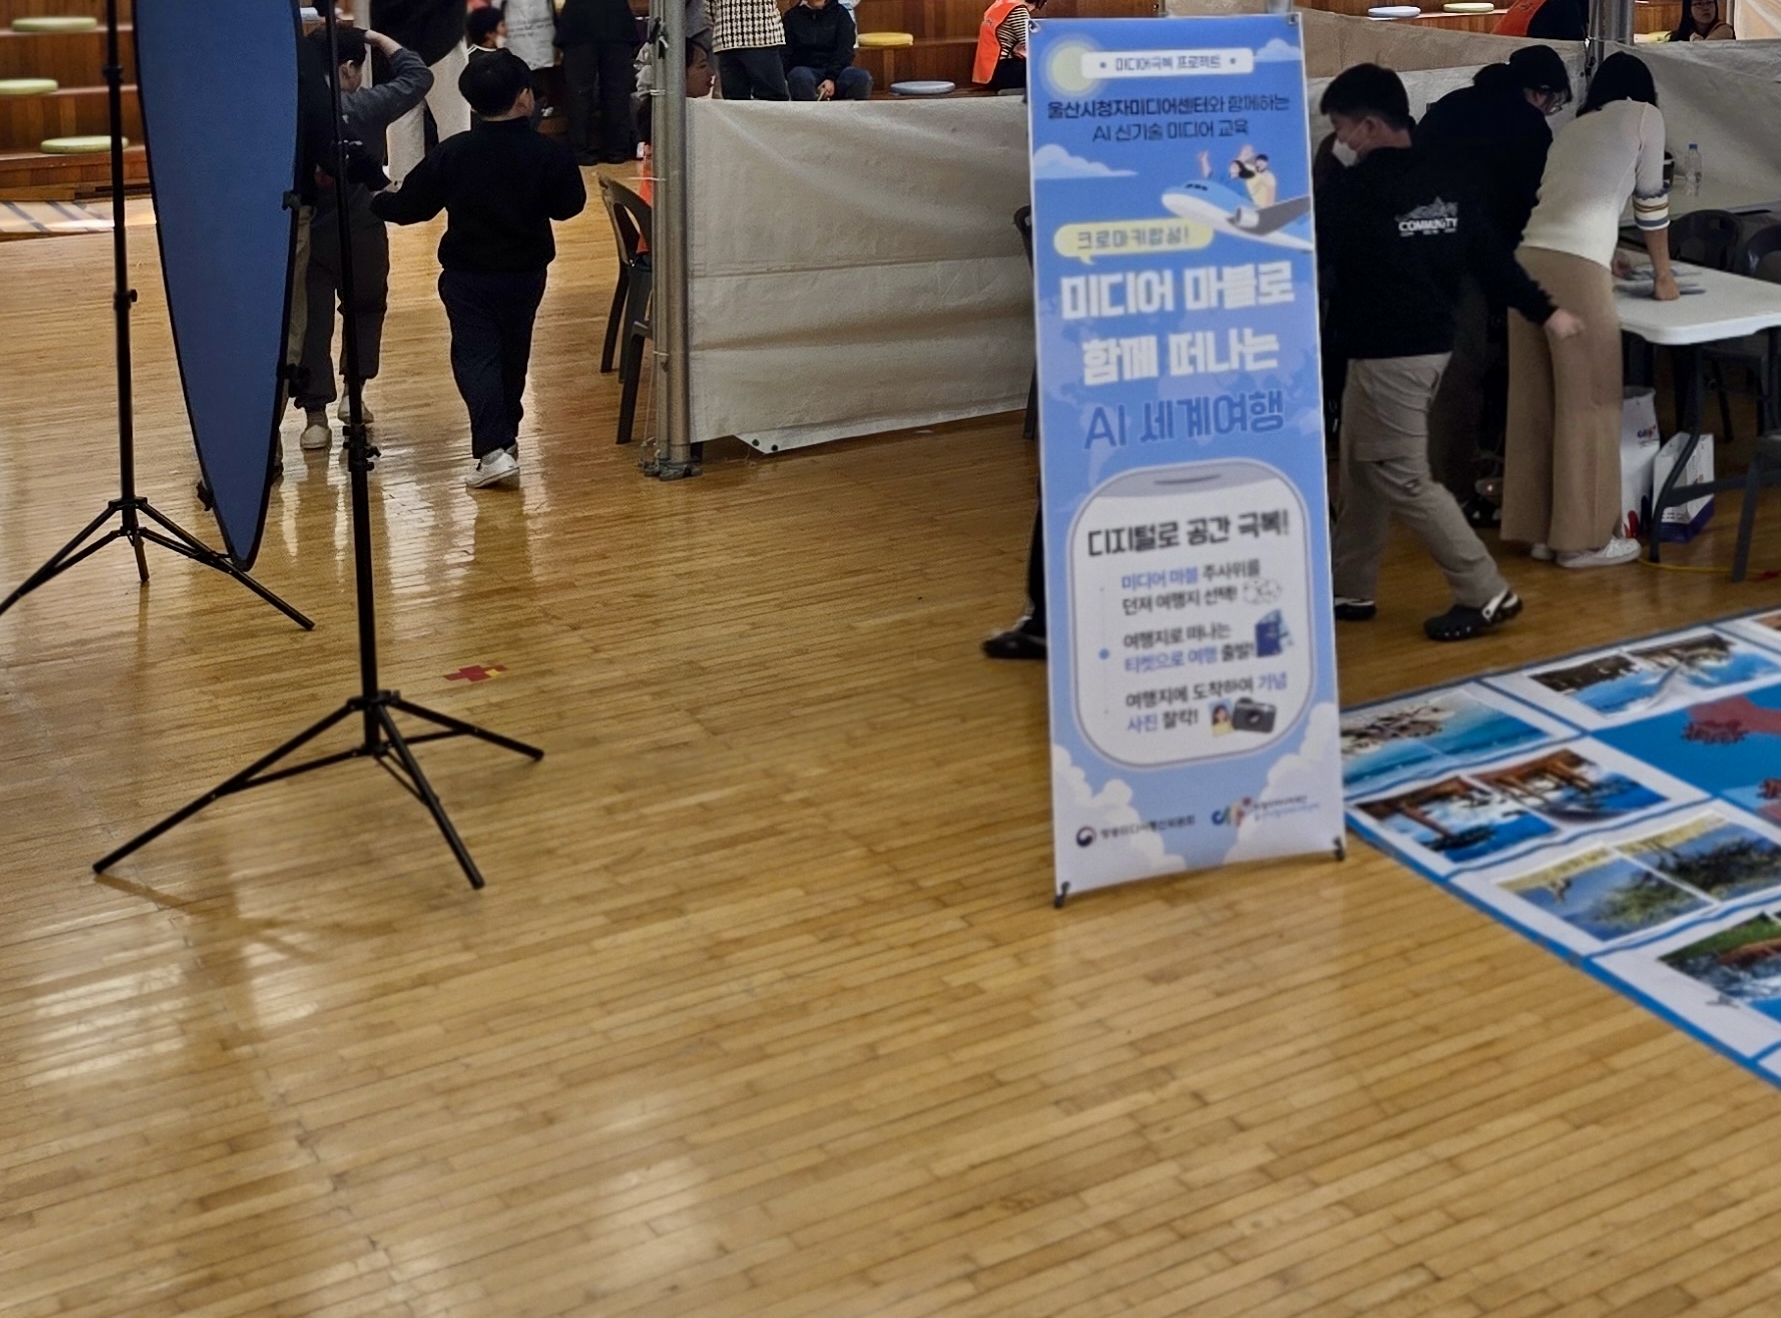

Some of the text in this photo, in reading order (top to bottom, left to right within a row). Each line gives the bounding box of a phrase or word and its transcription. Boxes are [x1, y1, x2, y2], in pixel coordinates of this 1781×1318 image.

[1048, 93, 1290, 119] 울산시청자미디어센터와 함께하는
[1092, 118, 1248, 142] AI 신기술 미디어 교육
[1061, 260, 1295, 320] 미디어 마블로
[1082, 327, 1280, 386] 함께 떠나는
[1084, 390, 1284, 450] AI 세계여행
[1088, 509, 1290, 557] 디지털로 공간 극복!
[1121, 558, 1261, 591] 미디어 마블 주사위를
[1156, 589, 1200, 610] 여행지
[1124, 623, 1231, 649] 여행지로 떠나는
[1125, 650, 1184, 673] 티켓으로
[1126, 686, 1188, 709] 여행지에
[1128, 713, 1158, 733] 사진
